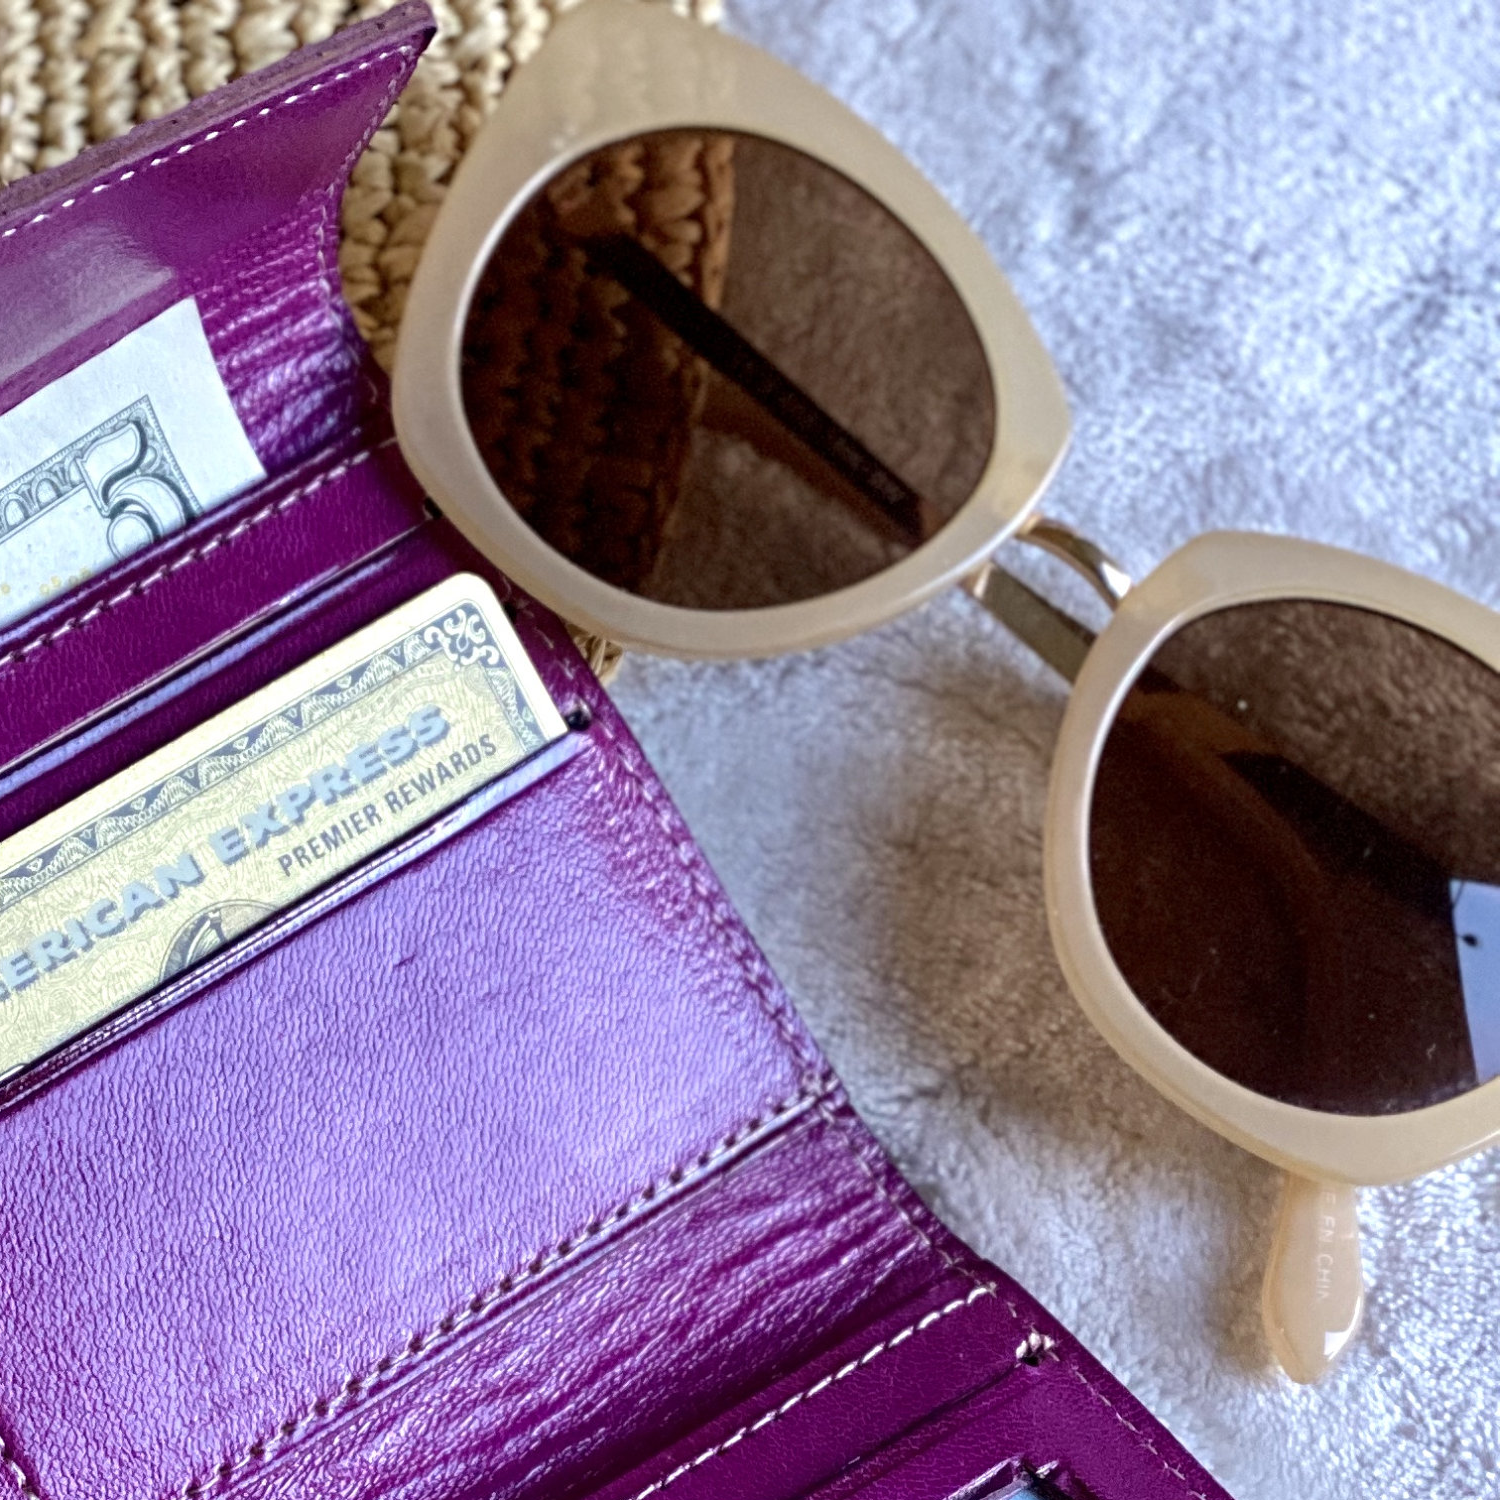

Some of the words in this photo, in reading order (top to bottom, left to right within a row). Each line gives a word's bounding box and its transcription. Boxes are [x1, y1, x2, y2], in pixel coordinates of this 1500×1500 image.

[74, 418, 197, 562] 5
[208, 703, 451, 865] EXPRESS
[278, 804, 382, 877] PREMIER
[384, 733, 498, 814] REWARDS
